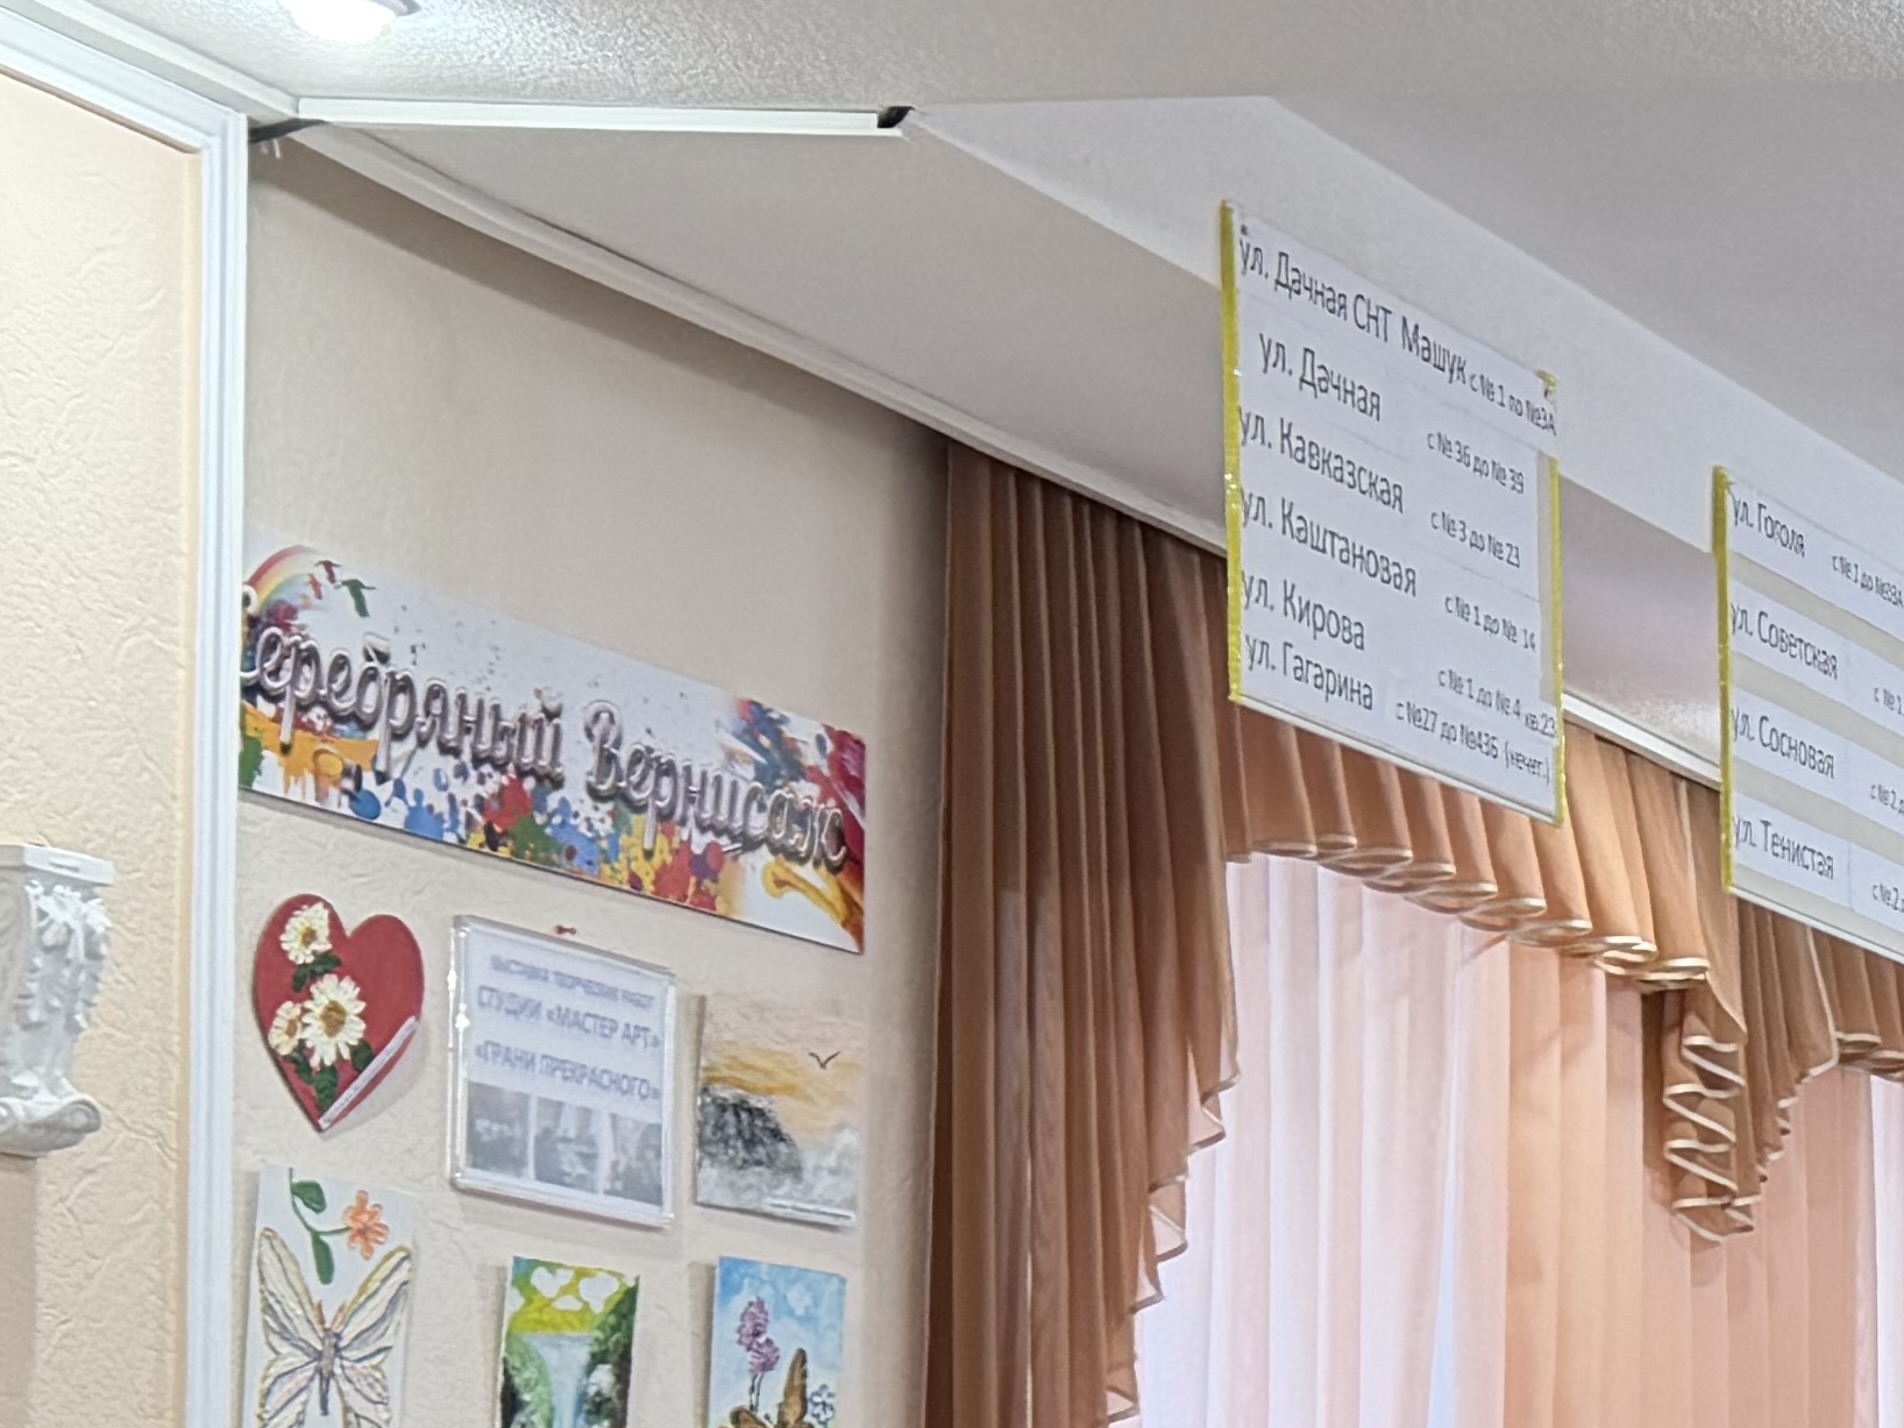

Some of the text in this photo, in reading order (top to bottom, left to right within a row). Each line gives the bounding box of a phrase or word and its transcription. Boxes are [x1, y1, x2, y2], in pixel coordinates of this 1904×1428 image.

[1239, 238, 1268, 279] ул.
[1274, 252, 1348, 321] Дачная
[1353, 294, 1394, 343] СНТ
[1402, 316, 1466, 384] Машук
[1259, 333, 1292, 376] ул.
[1299, 347, 1381, 422] Дачная
[1280, 417, 1404, 514] Кавказская
[1281, 497, 1417, 598] Каштановая
[1757, 502, 1805, 558] Гоголя
[1283, 580, 1365, 651] Кирова
[1757, 611, 1838, 681] Советская
[1244, 634, 1276, 672] ул.
[1282, 641, 1373, 711] Гагарина
[584, 700, 850, 871] Вернисаж
[1759, 715, 1835, 780] Сосновая
[1760, 820, 1834, 880] Тенистая
